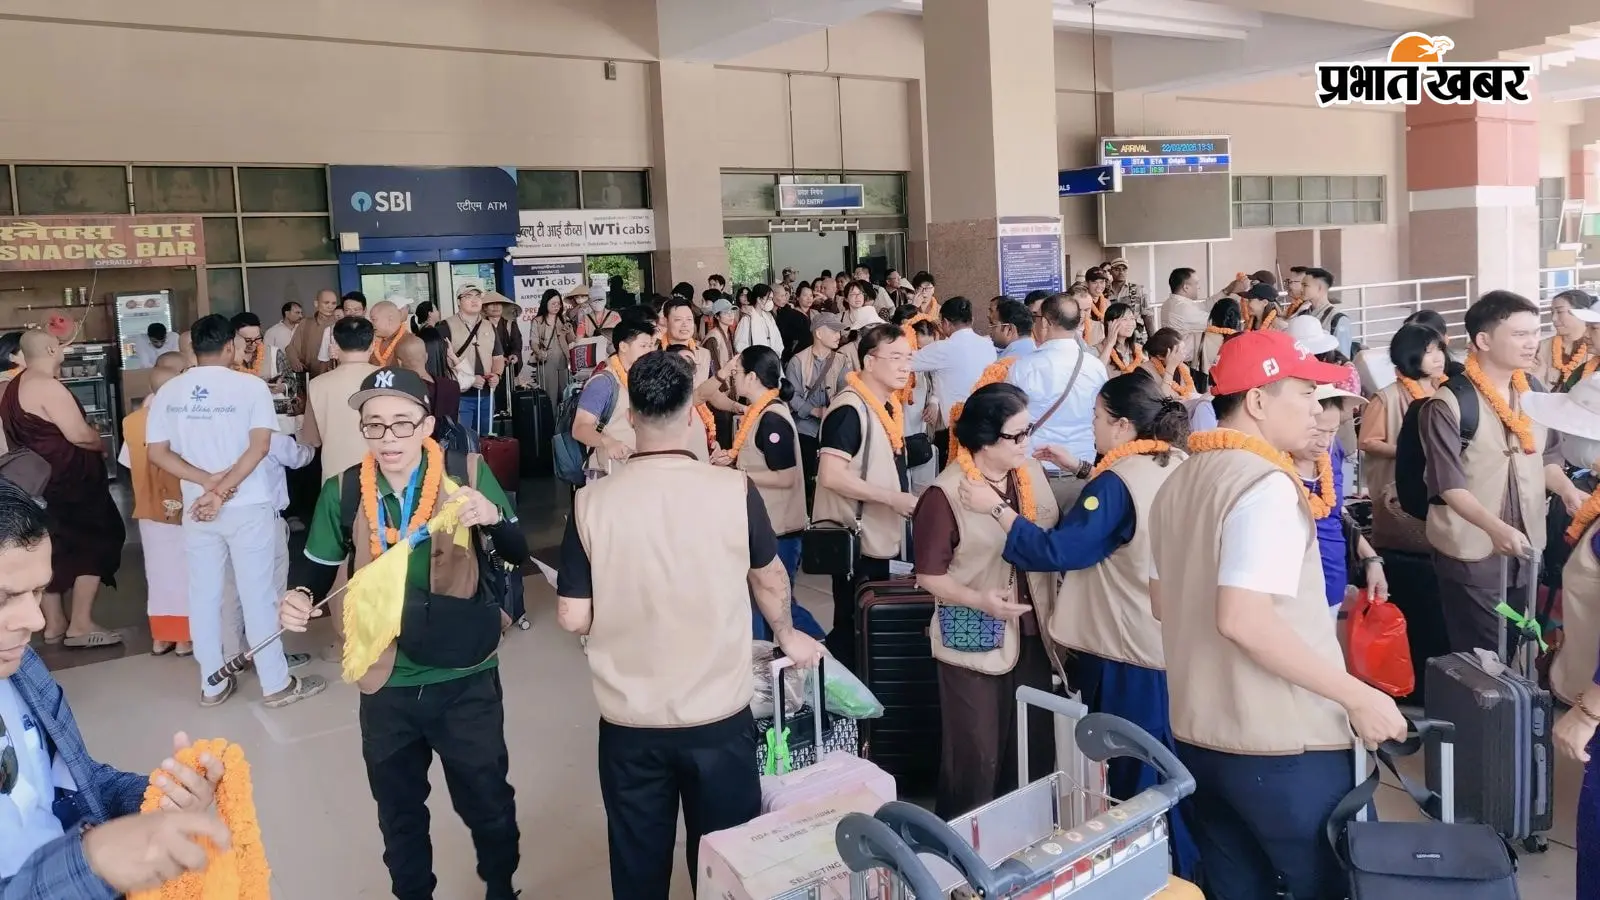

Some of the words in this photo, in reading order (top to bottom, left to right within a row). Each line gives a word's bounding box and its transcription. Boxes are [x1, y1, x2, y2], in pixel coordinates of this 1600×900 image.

[374, 191, 412, 212] SBI
[487, 201, 508, 211] ATM
[129, 224, 195, 238] बार
[589, 222, 620, 235] WTi
[622, 223, 650, 235] cabs
[0, 243, 126, 260] SNACKS
[136, 241, 196, 257] BAR
[522, 277, 549, 287] WTi
[552, 276, 576, 286] cabs
[789, 861, 842, 886] SELECTING
